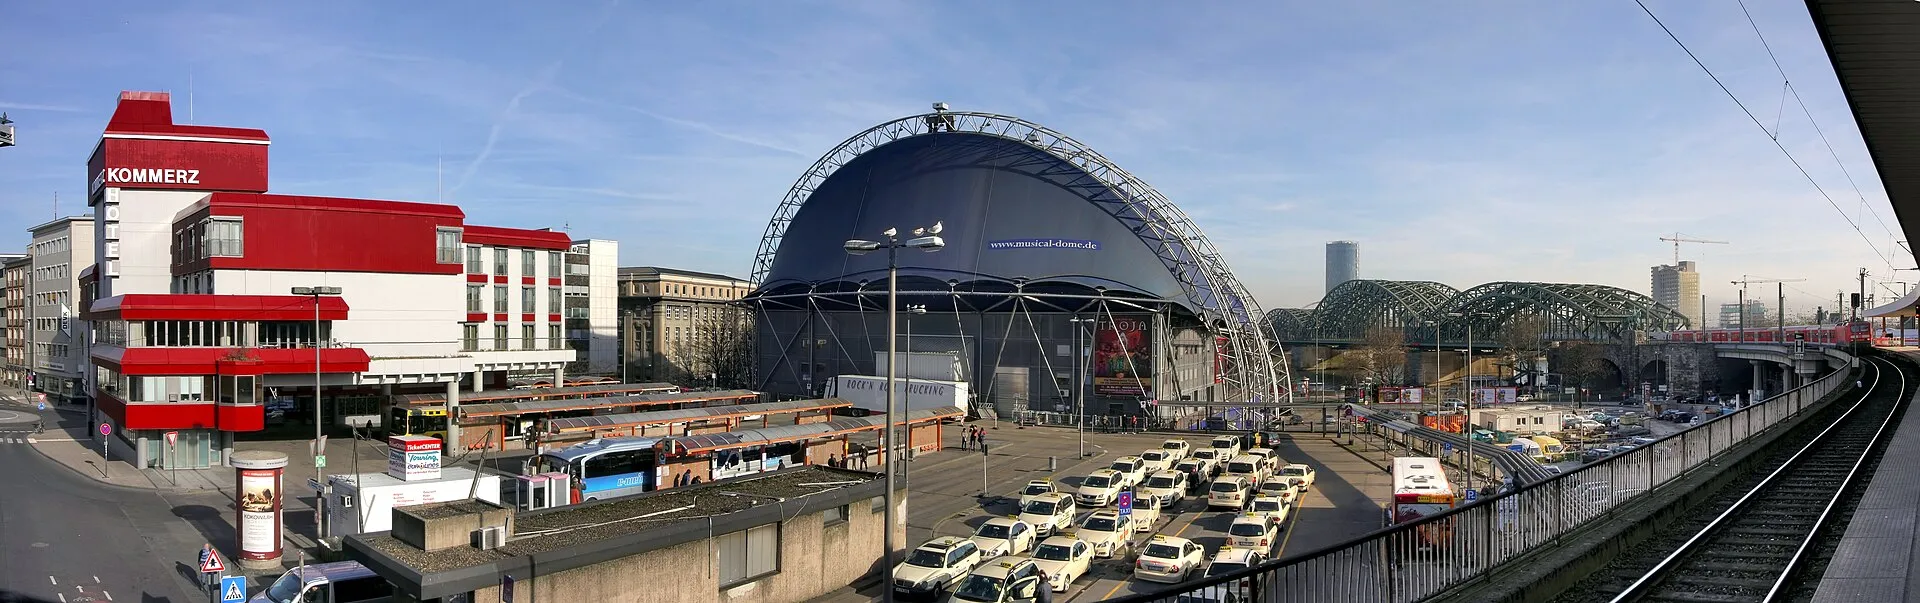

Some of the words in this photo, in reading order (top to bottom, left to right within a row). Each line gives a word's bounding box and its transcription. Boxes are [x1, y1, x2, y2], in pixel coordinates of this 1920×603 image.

[107, 168, 200, 184] KOMMERZ
[106, 187, 120, 277] HOTEL
[990, 240, 1097, 249] www.musical-dome.de
[1099, 320, 1148, 332] TROJA
[1795, 340, 1803, 353] H
[846, 379, 873, 390] ROCK'N
[406, 443, 441, 451] TicketCENTER
[664, 440, 671, 452] 5
